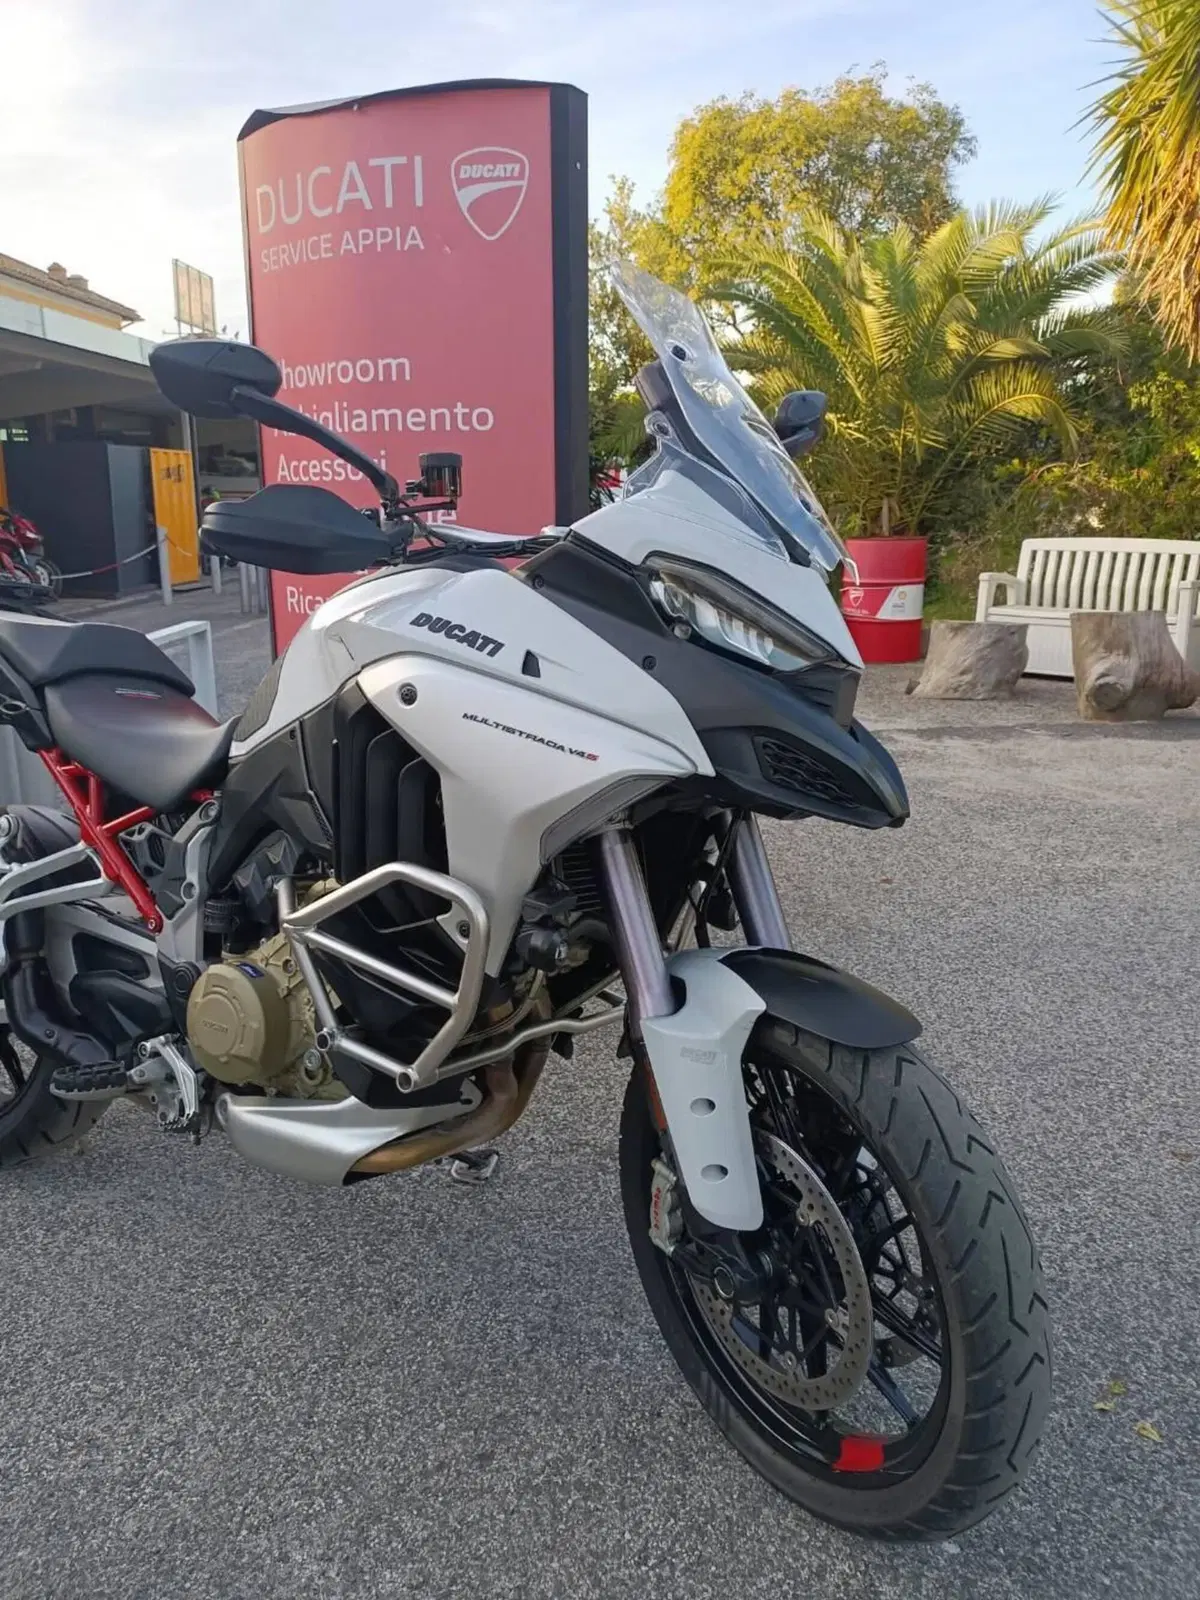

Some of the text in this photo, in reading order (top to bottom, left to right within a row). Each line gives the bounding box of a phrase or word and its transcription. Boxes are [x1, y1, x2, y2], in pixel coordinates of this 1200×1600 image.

[459, 163, 521, 179] DUCATI
[256, 155, 424, 233] DUCATI
[261, 226, 425, 273] SERVICE APPIA
[281, 357, 411, 390] howroom
[277, 450, 386, 482] Accessoi
[409, 612, 505, 657] DUCATI
[462, 713, 599, 761] MULTISTRADA V4S
